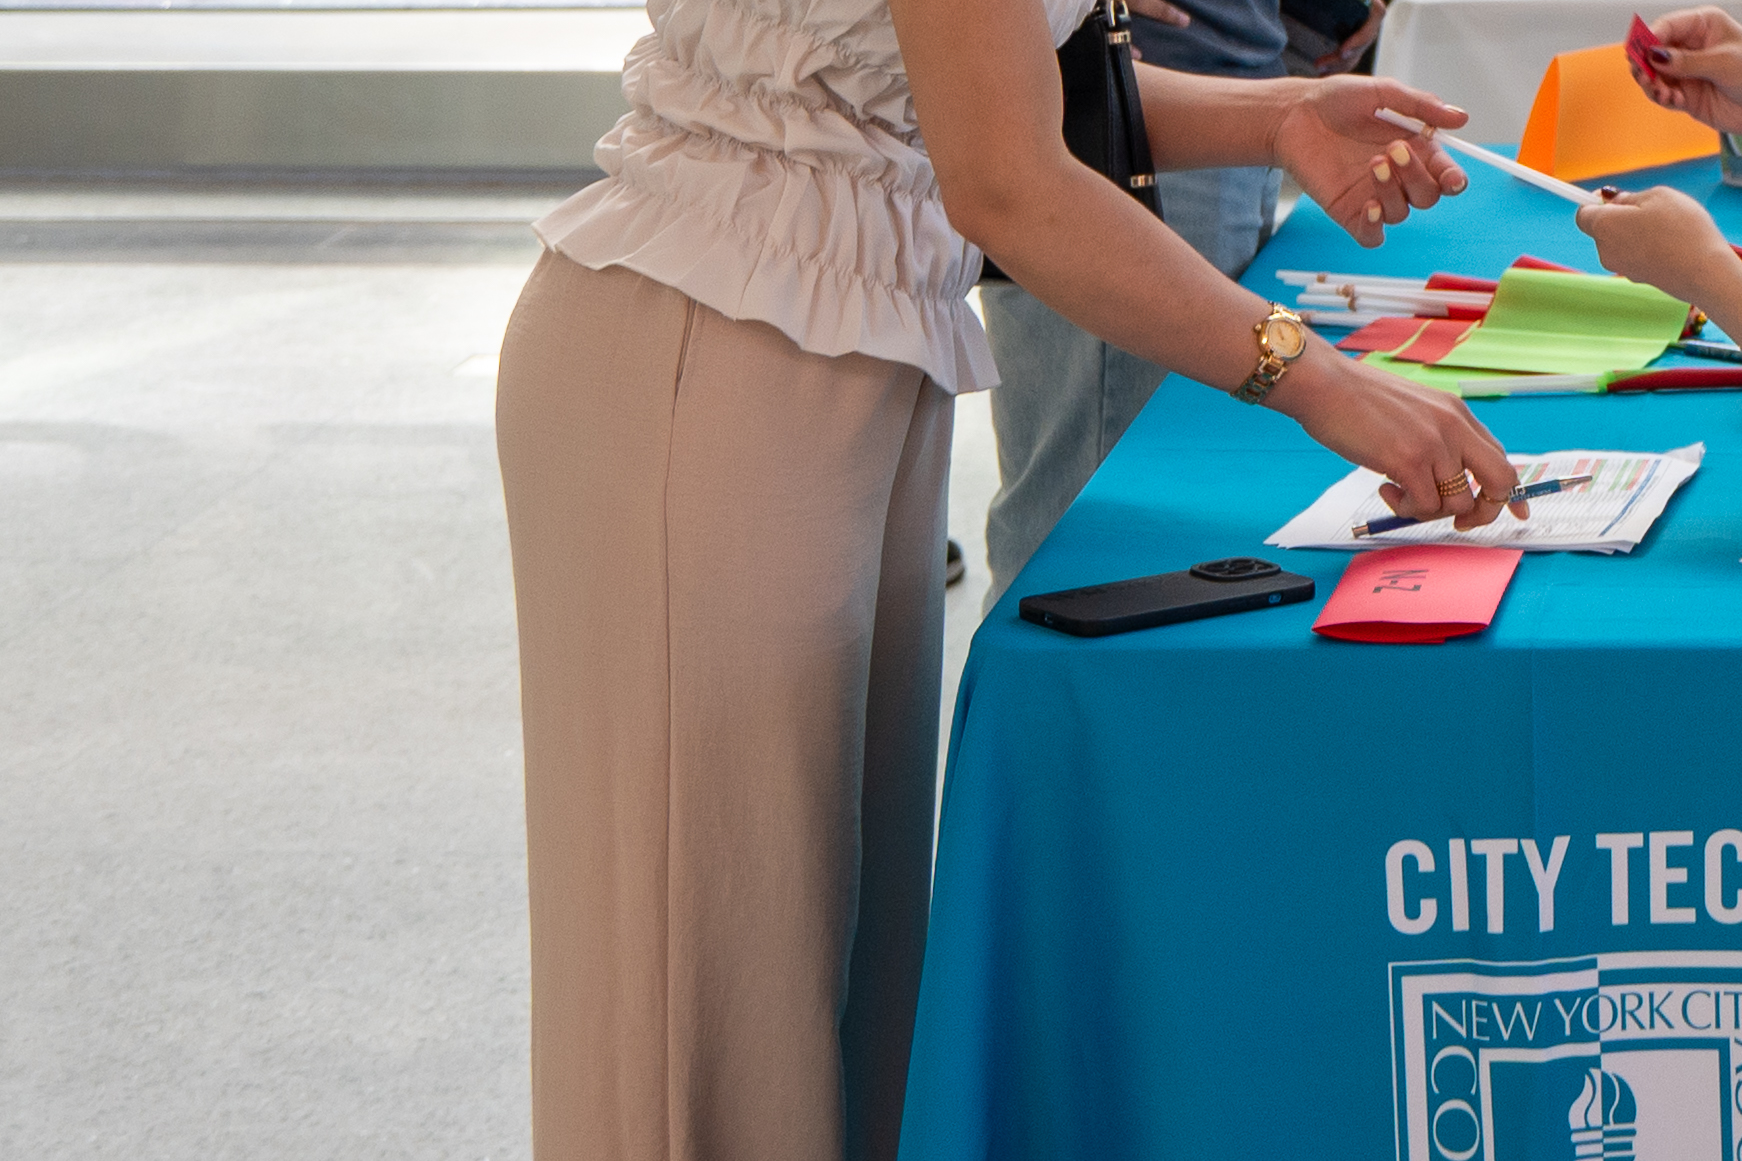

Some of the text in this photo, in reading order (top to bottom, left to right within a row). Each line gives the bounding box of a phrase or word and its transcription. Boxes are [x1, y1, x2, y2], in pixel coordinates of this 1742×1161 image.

[1385, 835, 1571, 935] CITY
[1431, 997, 1542, 1042] NEW
[1553, 990, 1676, 1036] YORK
